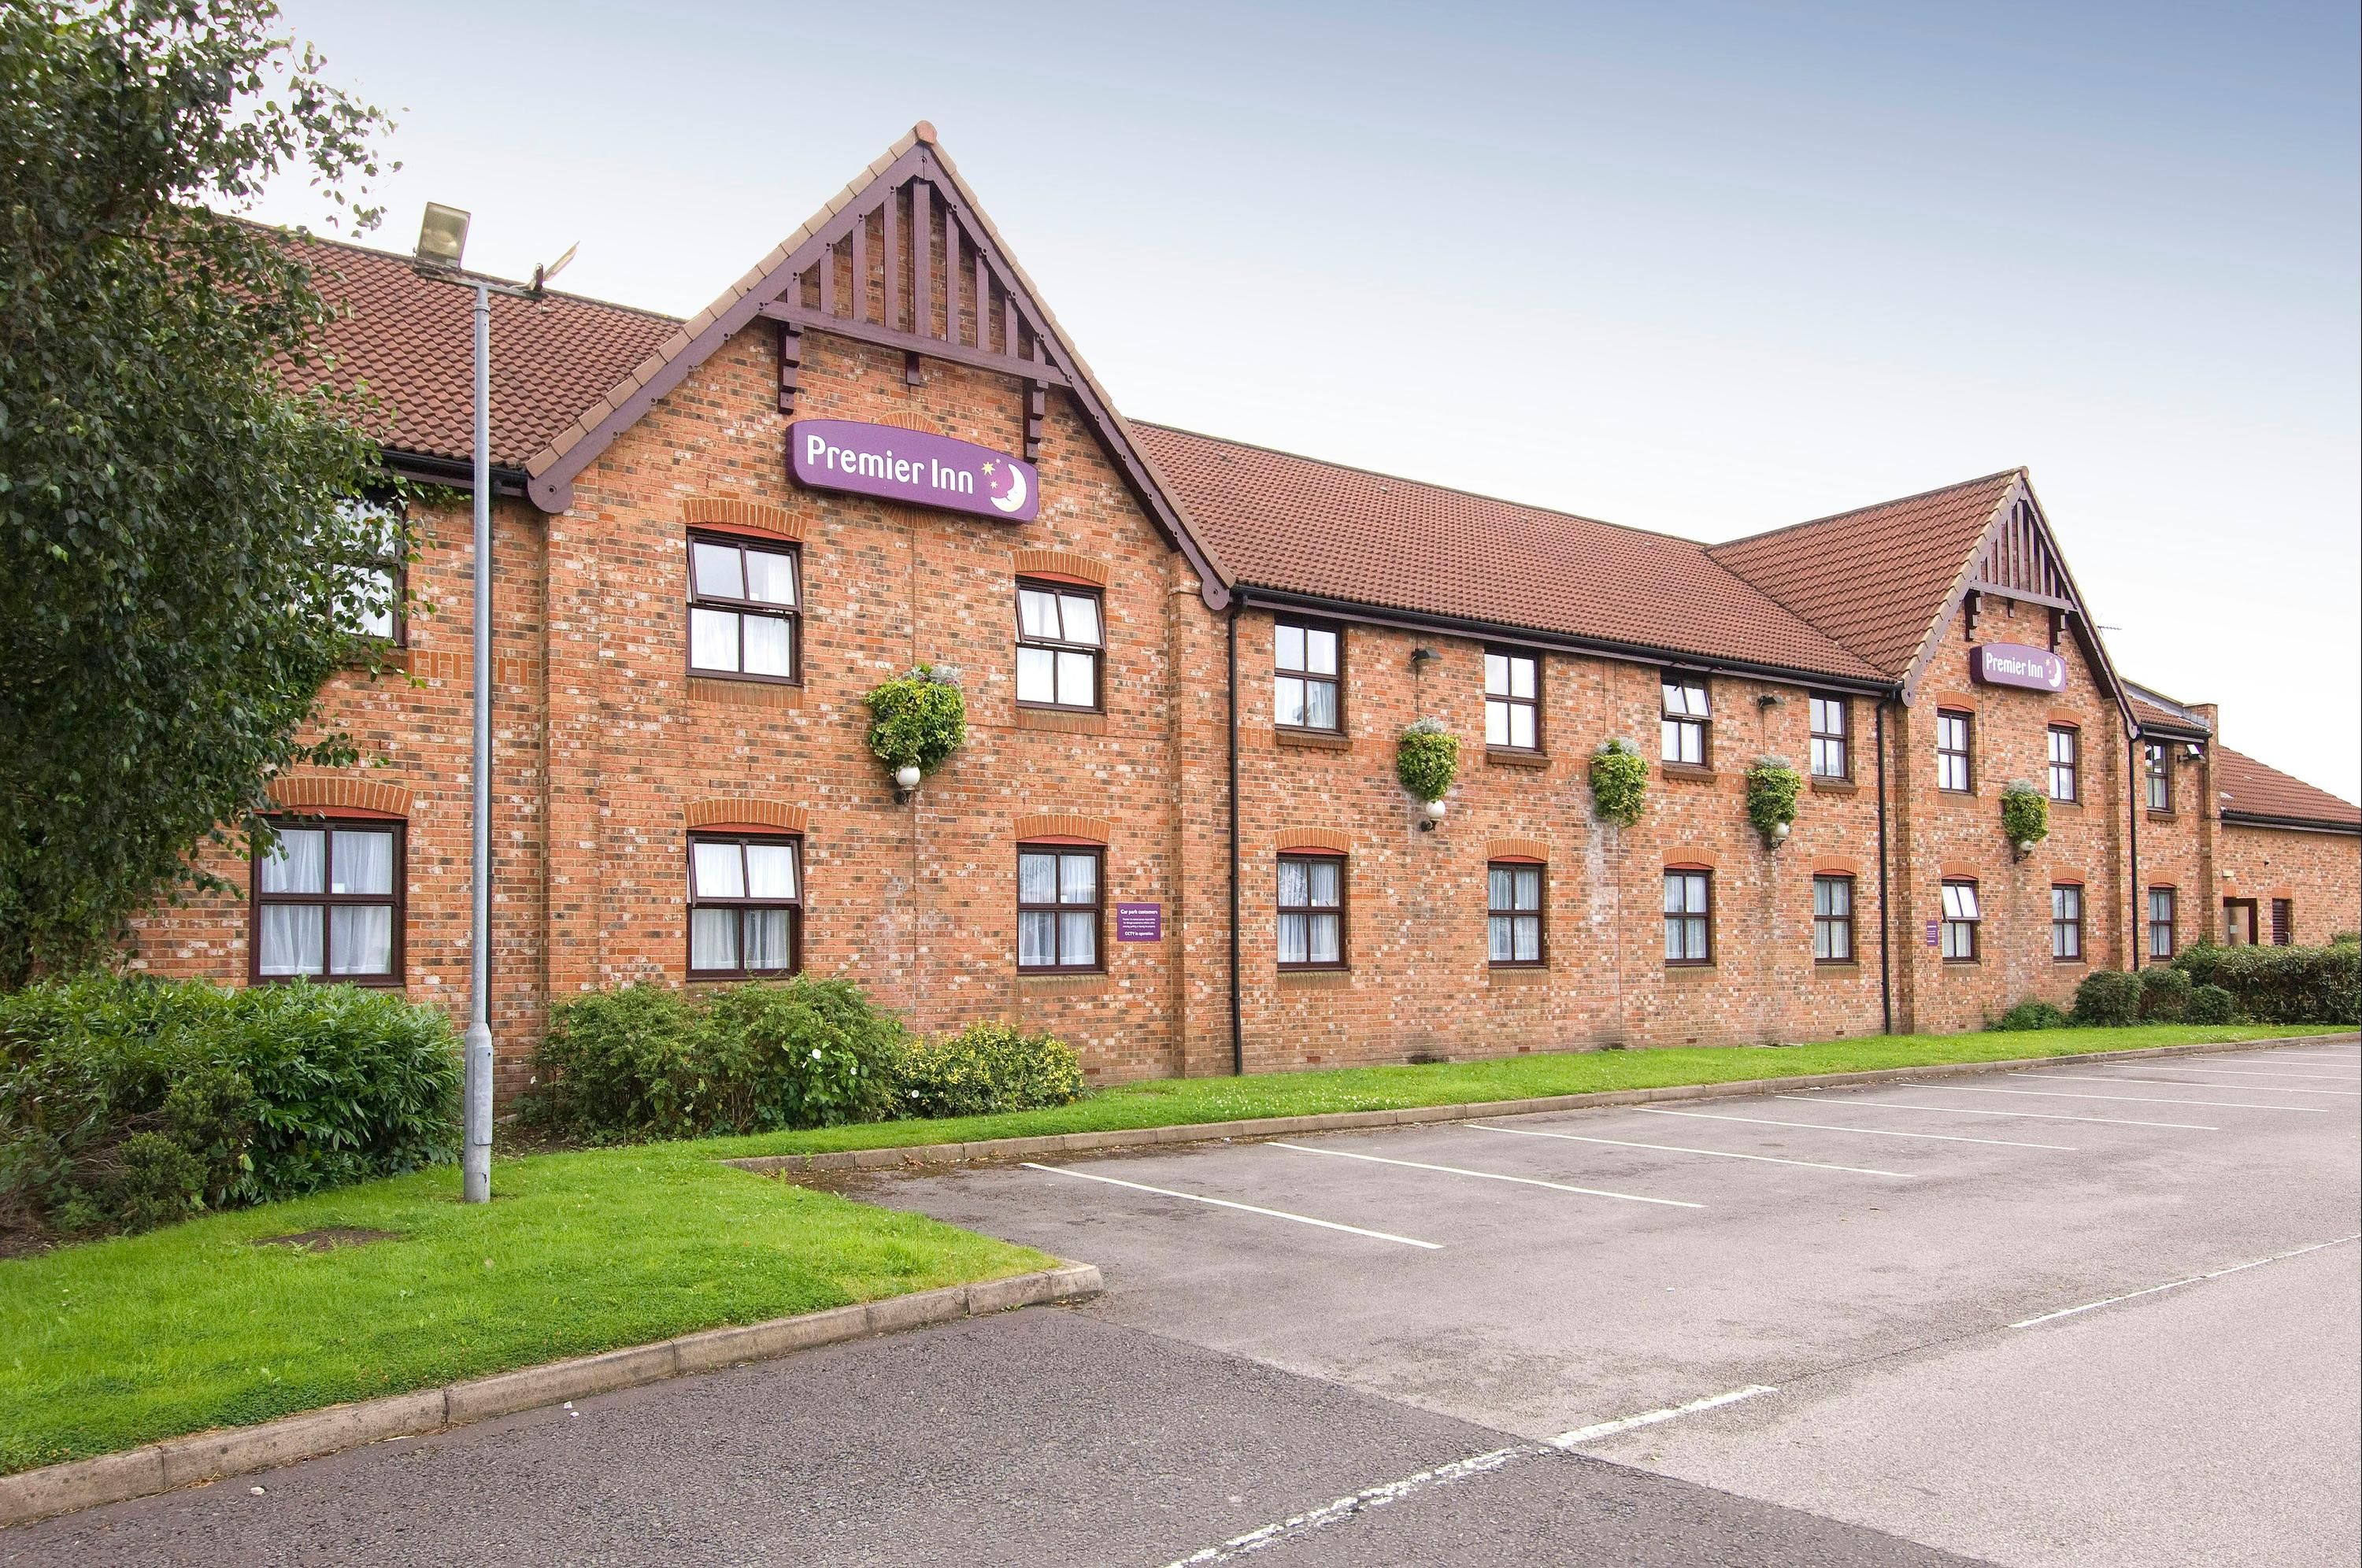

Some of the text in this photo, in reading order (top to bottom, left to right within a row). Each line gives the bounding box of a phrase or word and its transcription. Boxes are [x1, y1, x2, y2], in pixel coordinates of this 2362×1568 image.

[807, 434, 974, 494] Premier Inn
[1986, 652, 2043, 679] Premier Inn
